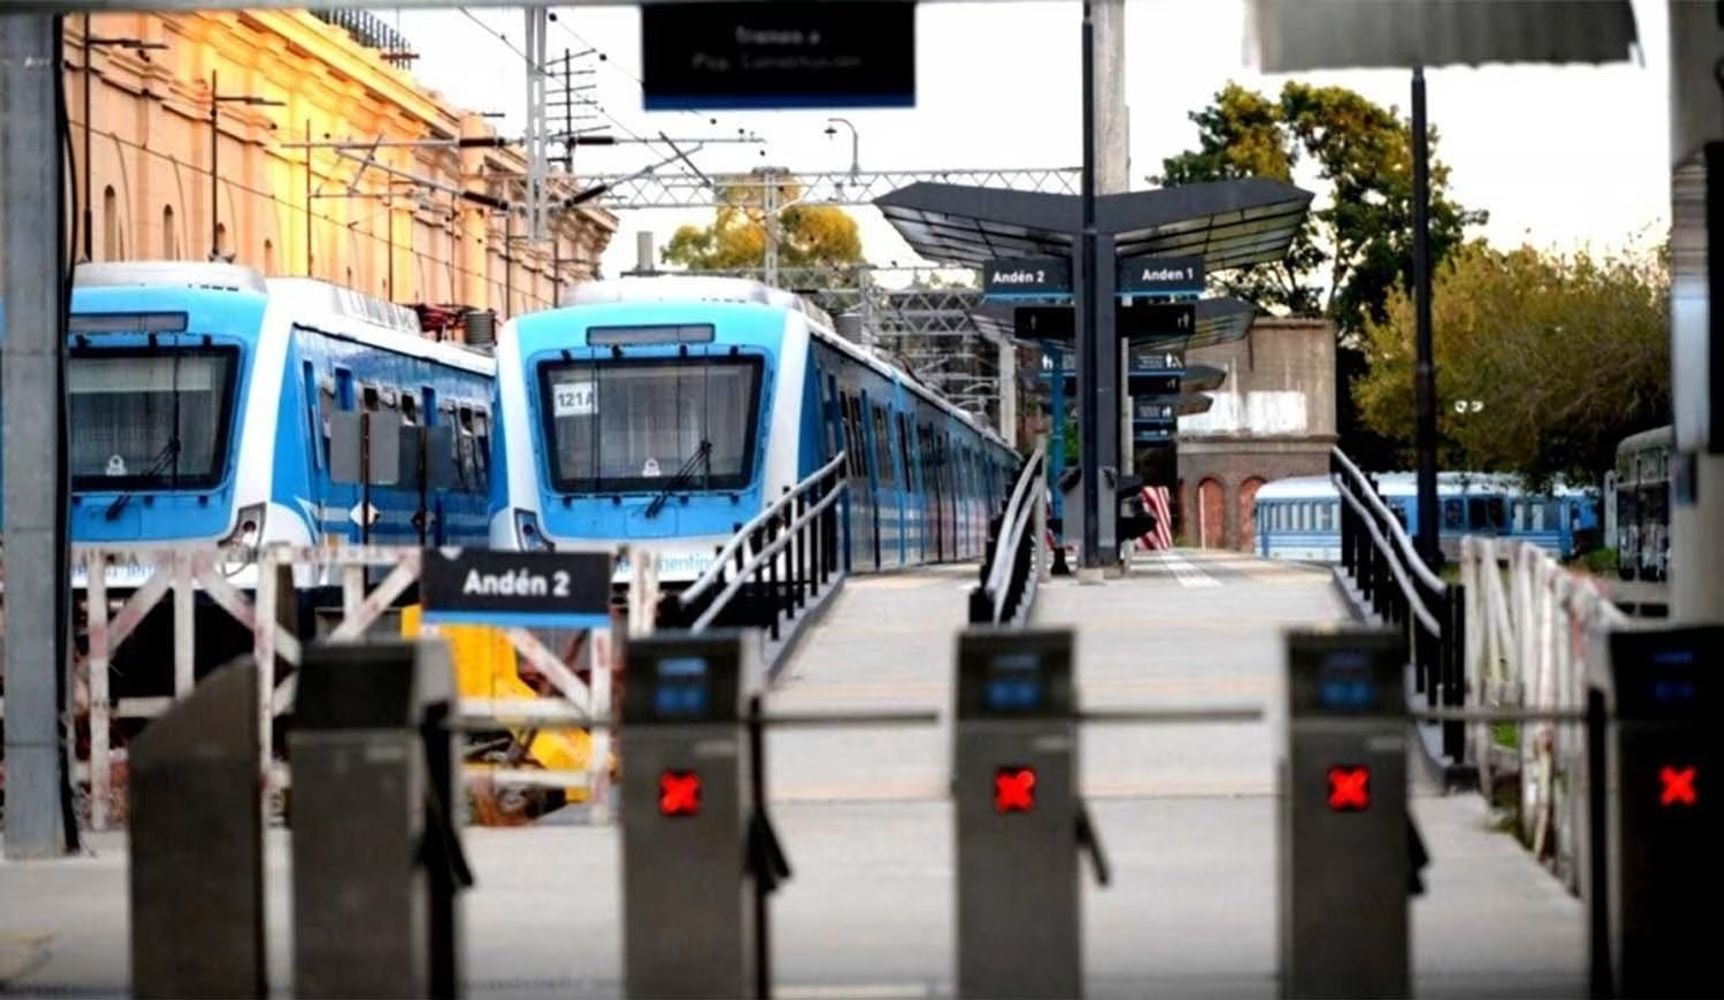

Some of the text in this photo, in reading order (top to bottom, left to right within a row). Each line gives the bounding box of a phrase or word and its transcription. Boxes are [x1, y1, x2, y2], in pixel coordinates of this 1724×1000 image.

[1036, 271, 1045, 283] 2
[1186, 267, 1194, 280] 1
[463, 568, 571, 596] Andén 2
